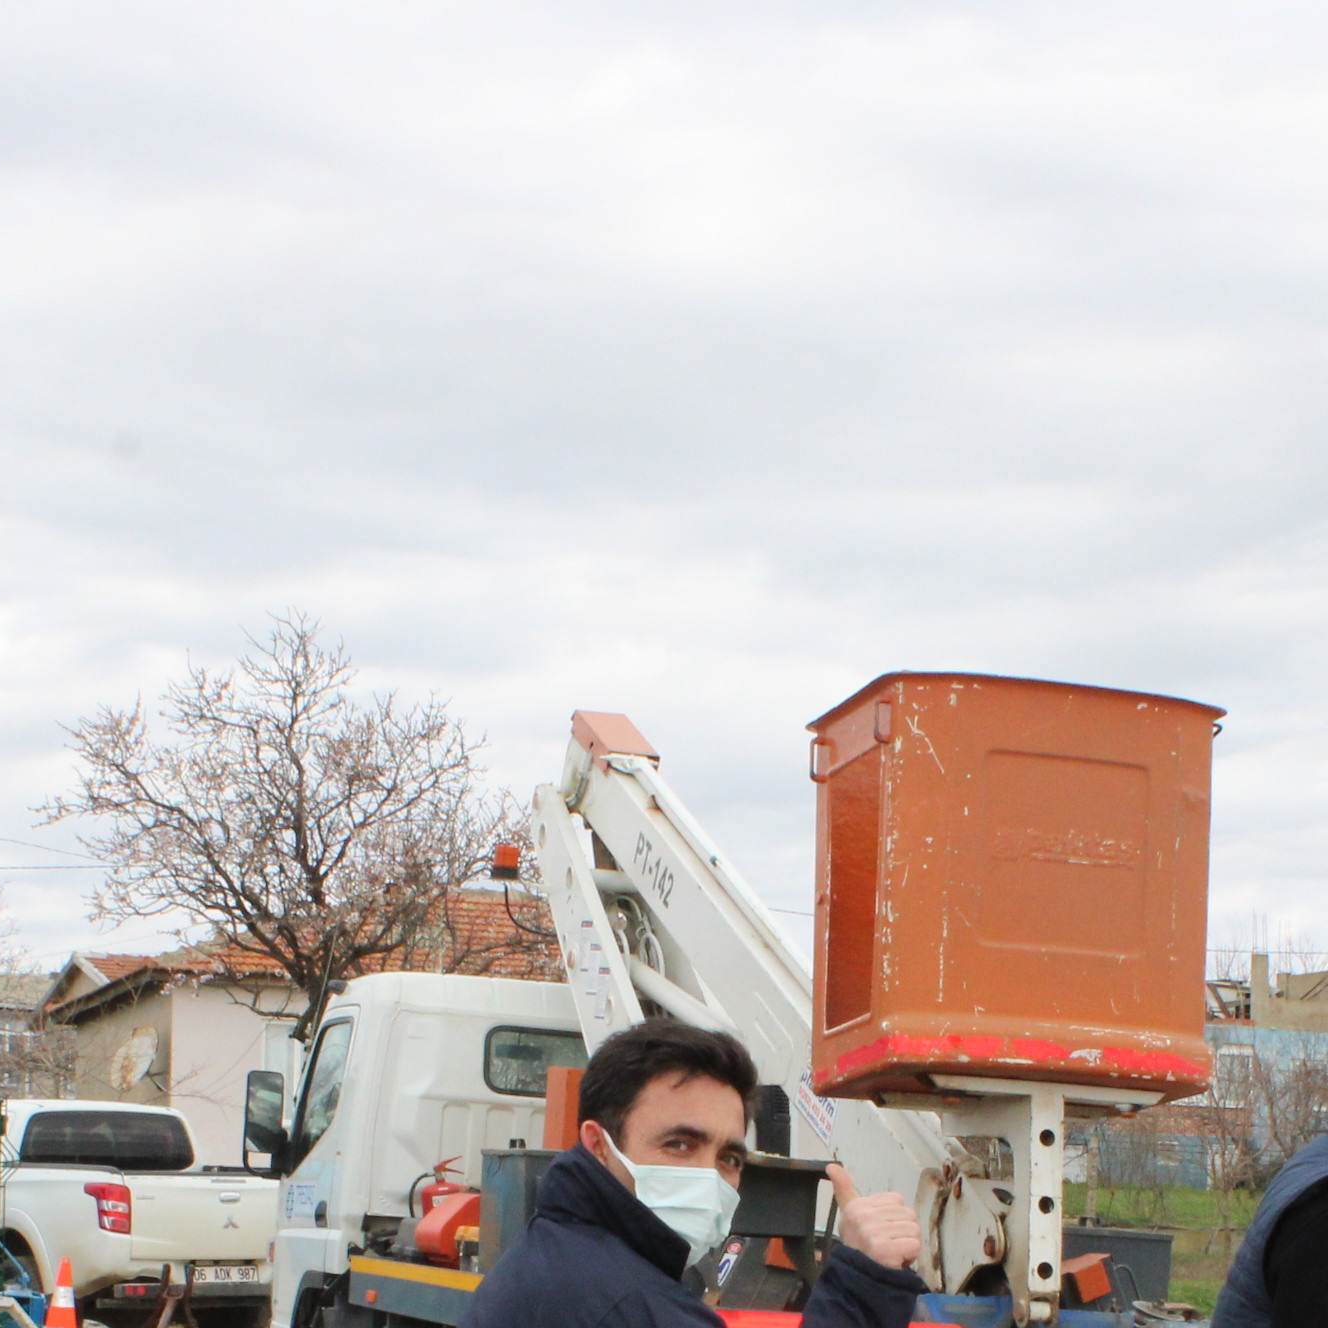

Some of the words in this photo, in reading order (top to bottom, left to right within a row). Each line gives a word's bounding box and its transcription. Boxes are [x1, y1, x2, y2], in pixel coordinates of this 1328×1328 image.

[633, 830, 674, 909] PT-142
[214, 1267, 232, 1281] ADK
[237, 1266, 257, 1280] 987
